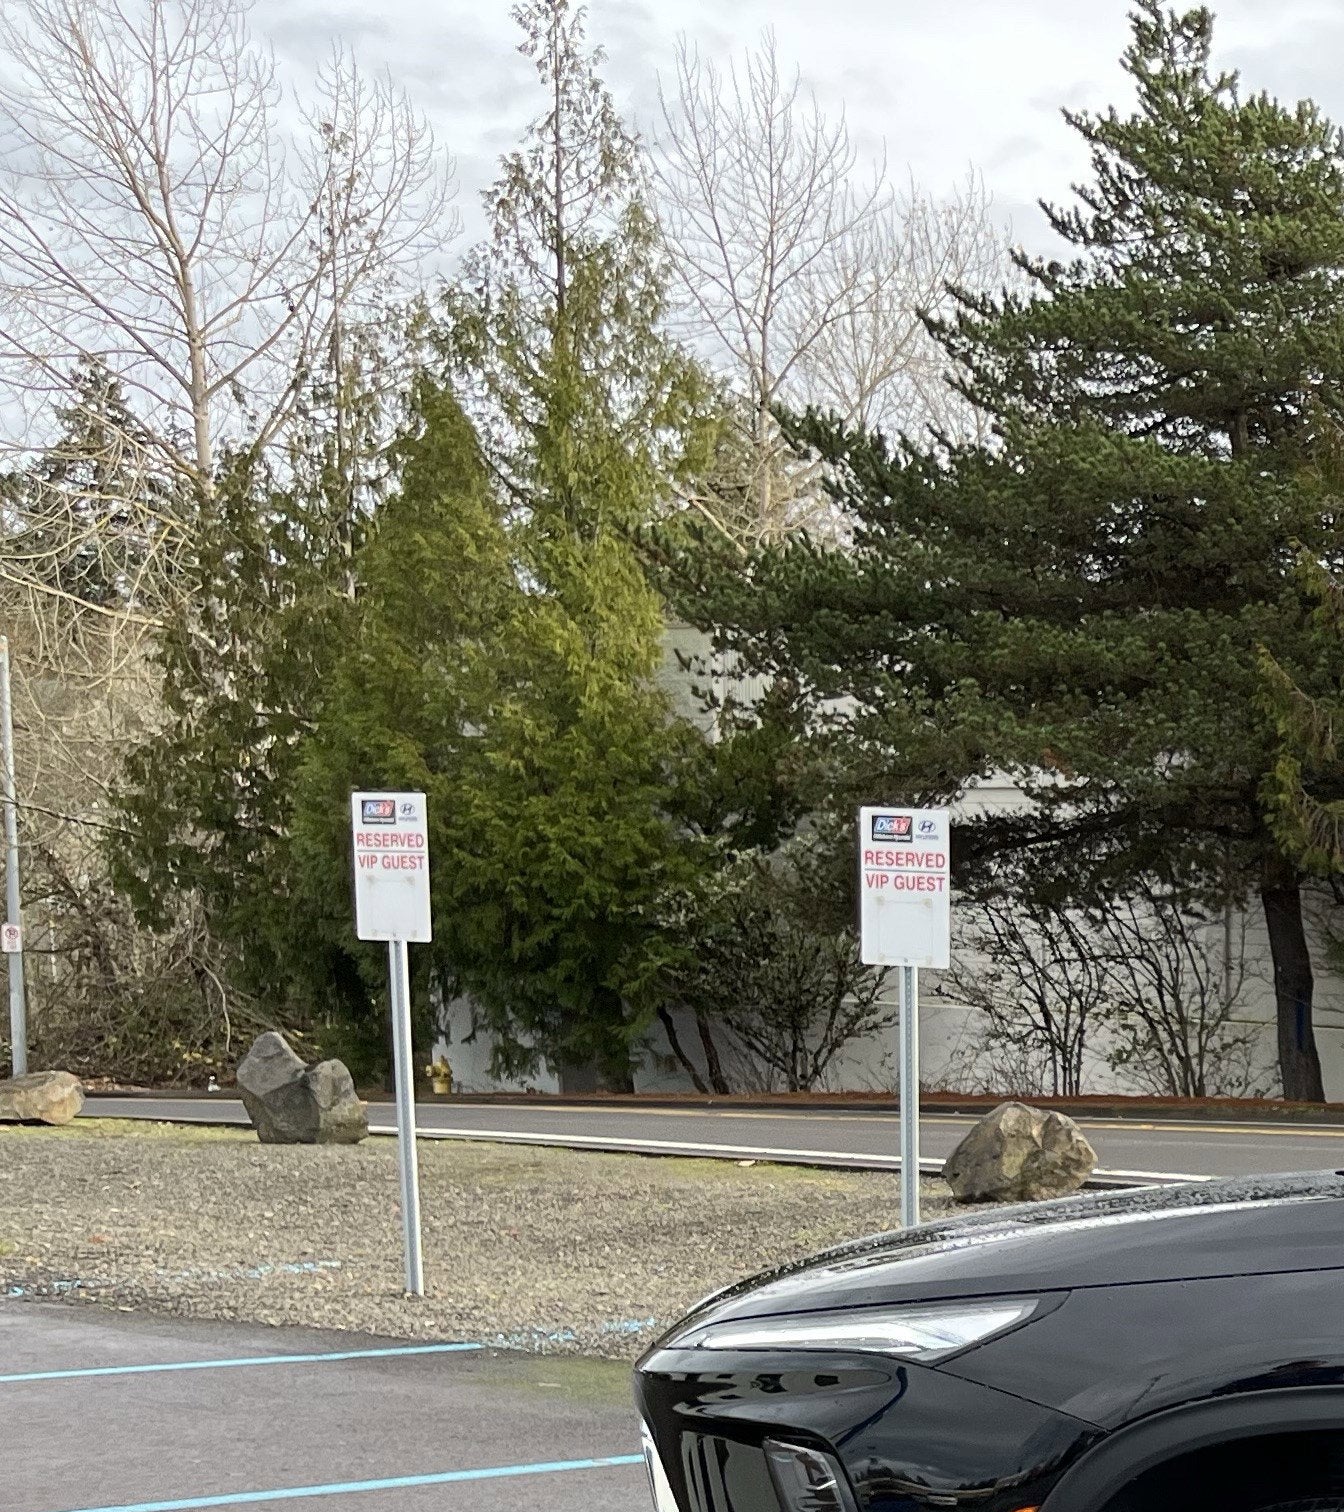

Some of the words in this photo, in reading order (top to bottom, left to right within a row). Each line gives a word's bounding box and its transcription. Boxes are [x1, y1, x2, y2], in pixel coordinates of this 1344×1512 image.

[356, 833, 424, 848] RESERVED
[358, 855, 378, 869] VIP
[382, 855, 424, 870] GUEST
[865, 851, 946, 868] RESERVED
[866, 873, 889, 889] VIP
[894, 875, 946, 892] GUEST
